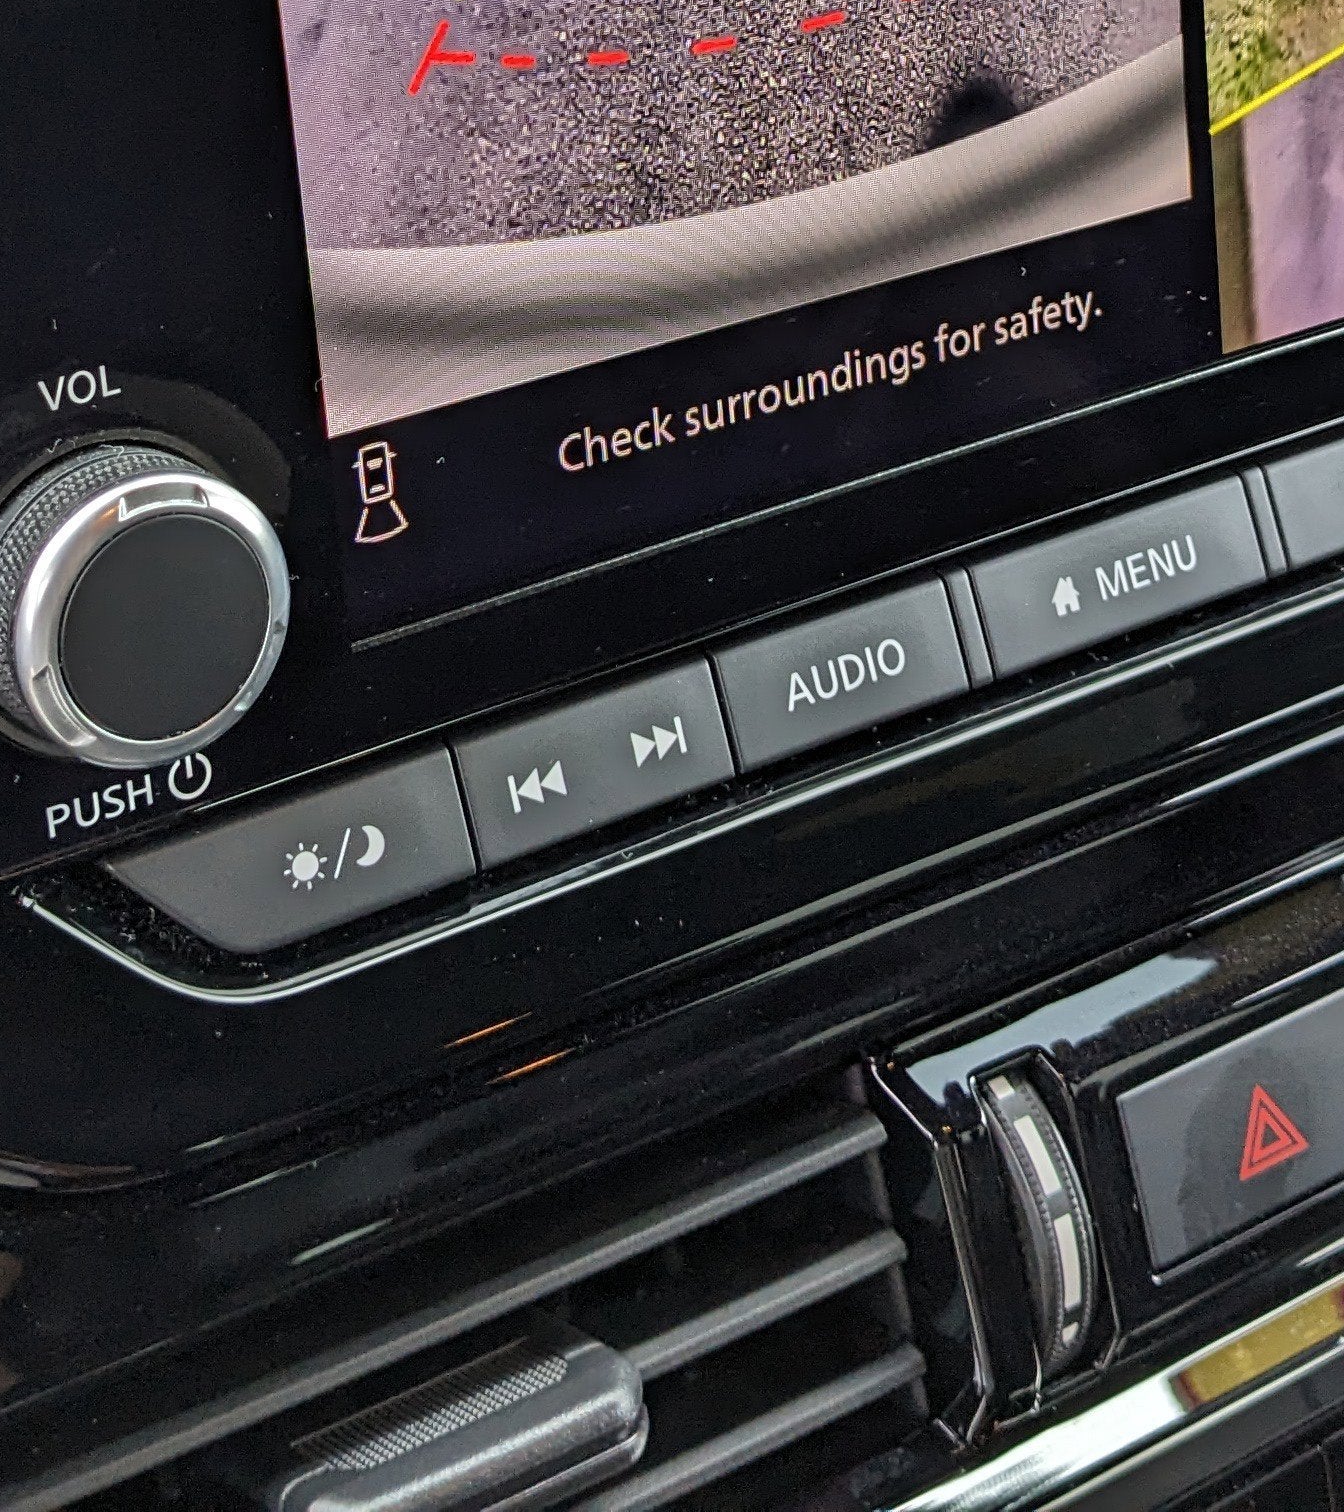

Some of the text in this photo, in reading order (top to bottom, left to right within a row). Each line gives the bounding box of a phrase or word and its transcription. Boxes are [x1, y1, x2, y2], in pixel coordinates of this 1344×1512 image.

[38, 365, 122, 411] VOL
[558, 288, 1104, 474] Check surroundings for safety.
[1096, 533, 1199, 602] MENU
[786, 638, 906, 713] AUDIO
[45, 775, 155, 838] PUSH
